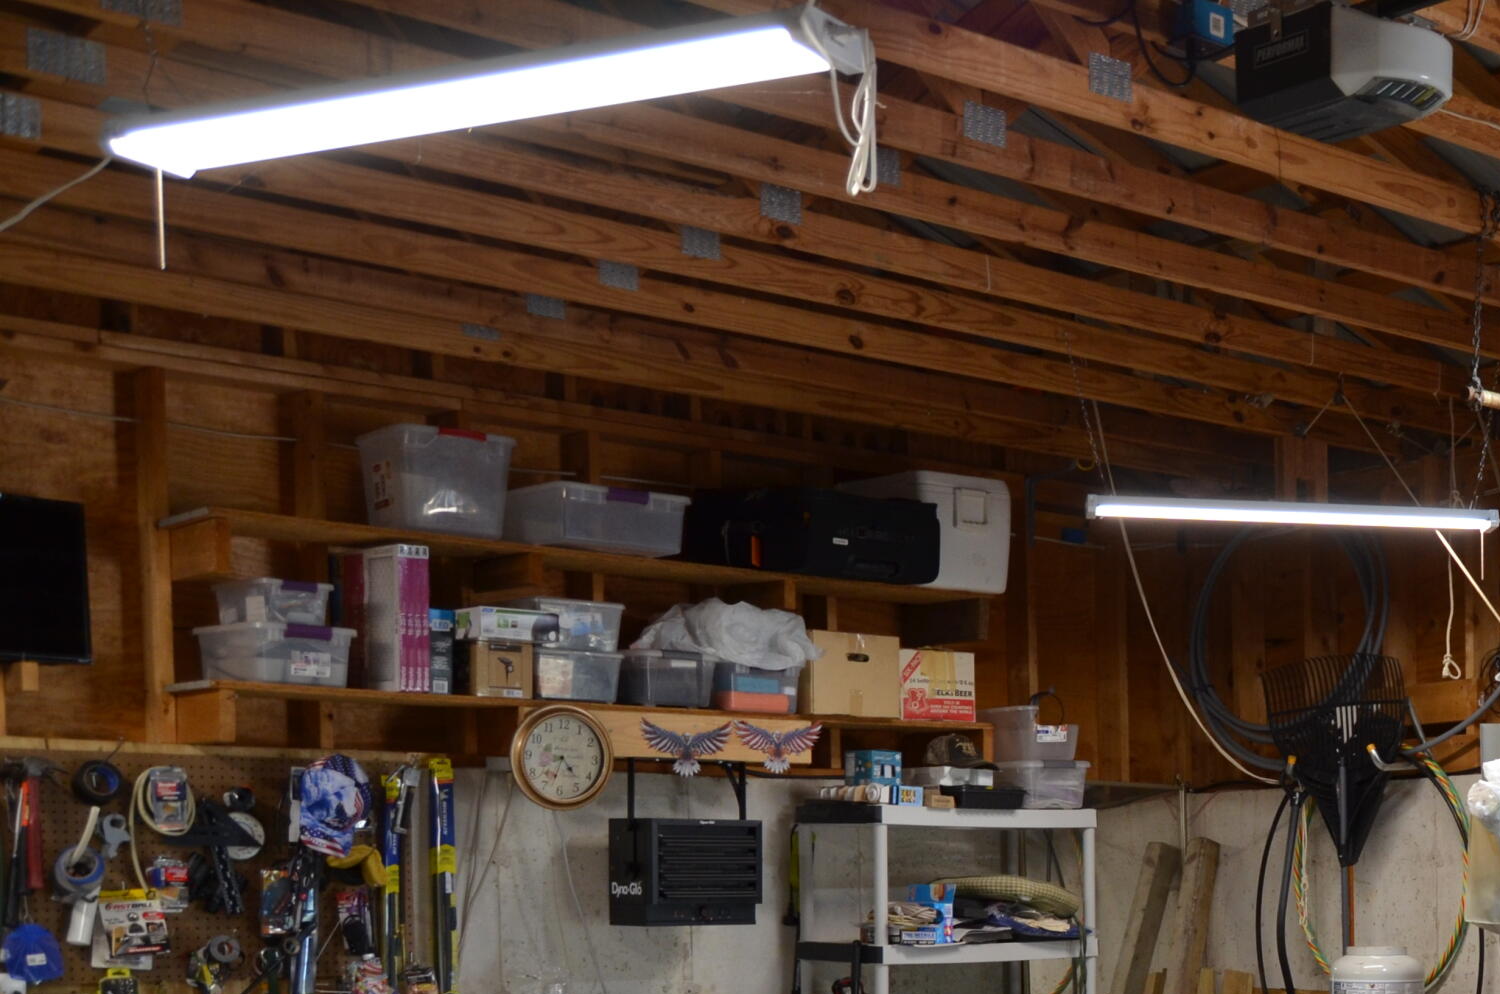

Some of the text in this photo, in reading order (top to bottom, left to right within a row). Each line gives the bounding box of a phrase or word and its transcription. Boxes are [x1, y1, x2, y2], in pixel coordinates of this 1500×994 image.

[543, 722, 553, 733] 11
[558, 719, 570, 730] 12
[576, 725, 582, 735] 1
[531, 733, 542, 744] 10
[587, 737, 594, 748] 2
[525, 750, 532, 761] 9
[591, 755, 598, 766] 3
[529, 767, 536, 778] 8
[585, 771, 592, 781] 4
[541, 780, 548, 791] 7
[556, 785, 563, 796] 6
[572, 782, 579, 793] 5
